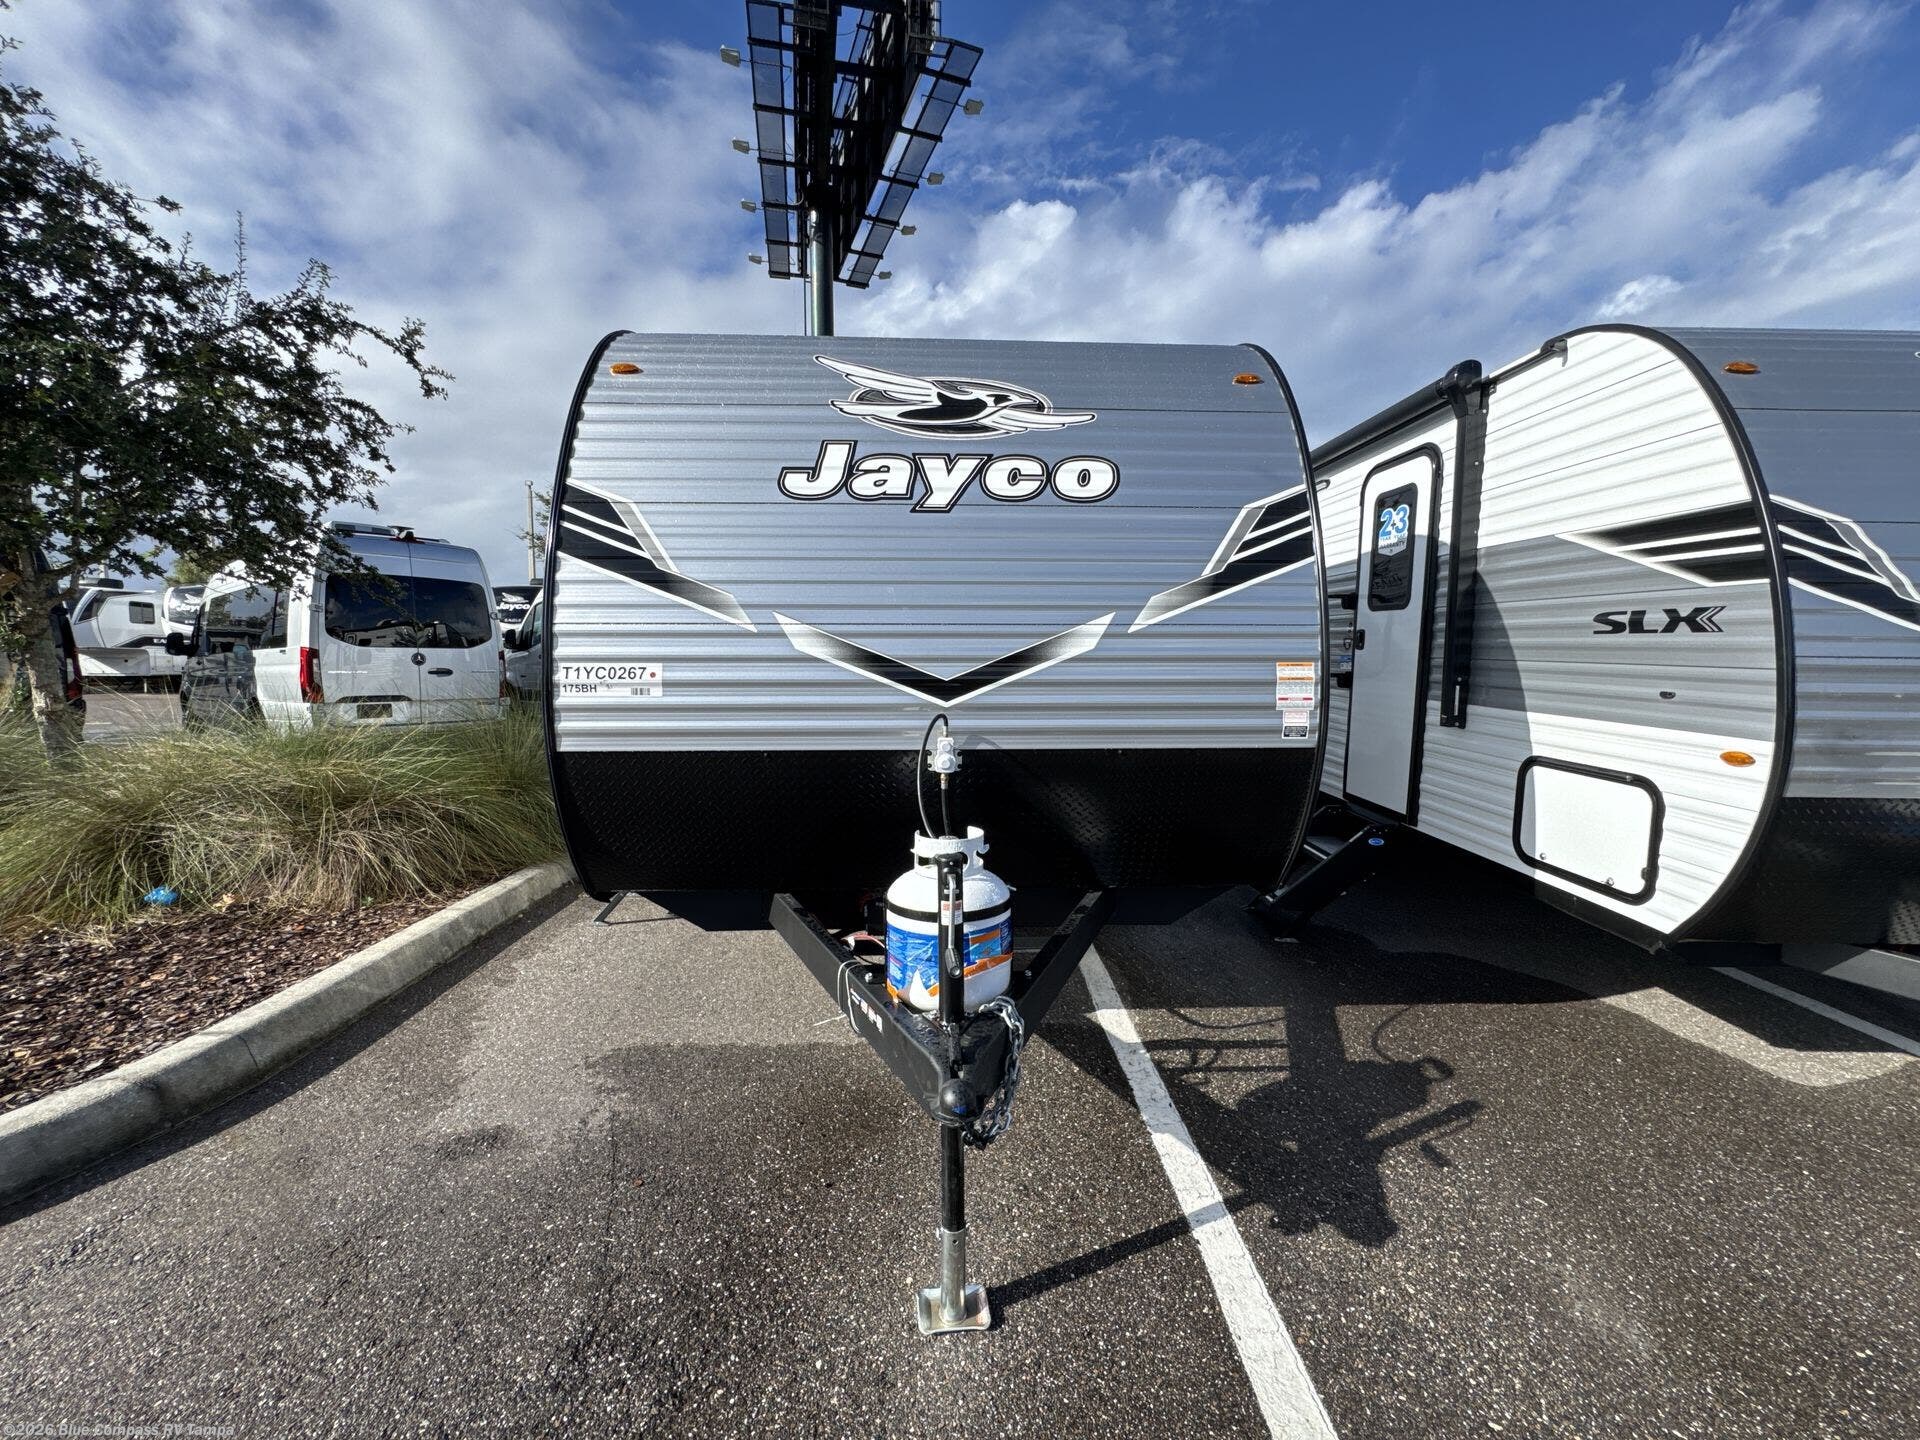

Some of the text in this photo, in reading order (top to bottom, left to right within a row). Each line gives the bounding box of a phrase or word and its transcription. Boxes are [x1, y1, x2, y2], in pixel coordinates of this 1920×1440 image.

[777, 440, 1121, 513] Jayco
[496, 602, 531, 611] Jayco
[1593, 605, 1727, 635] SLX
[562, 666, 647, 680] T1YC0267
[562, 684, 598, 693] 175BH
